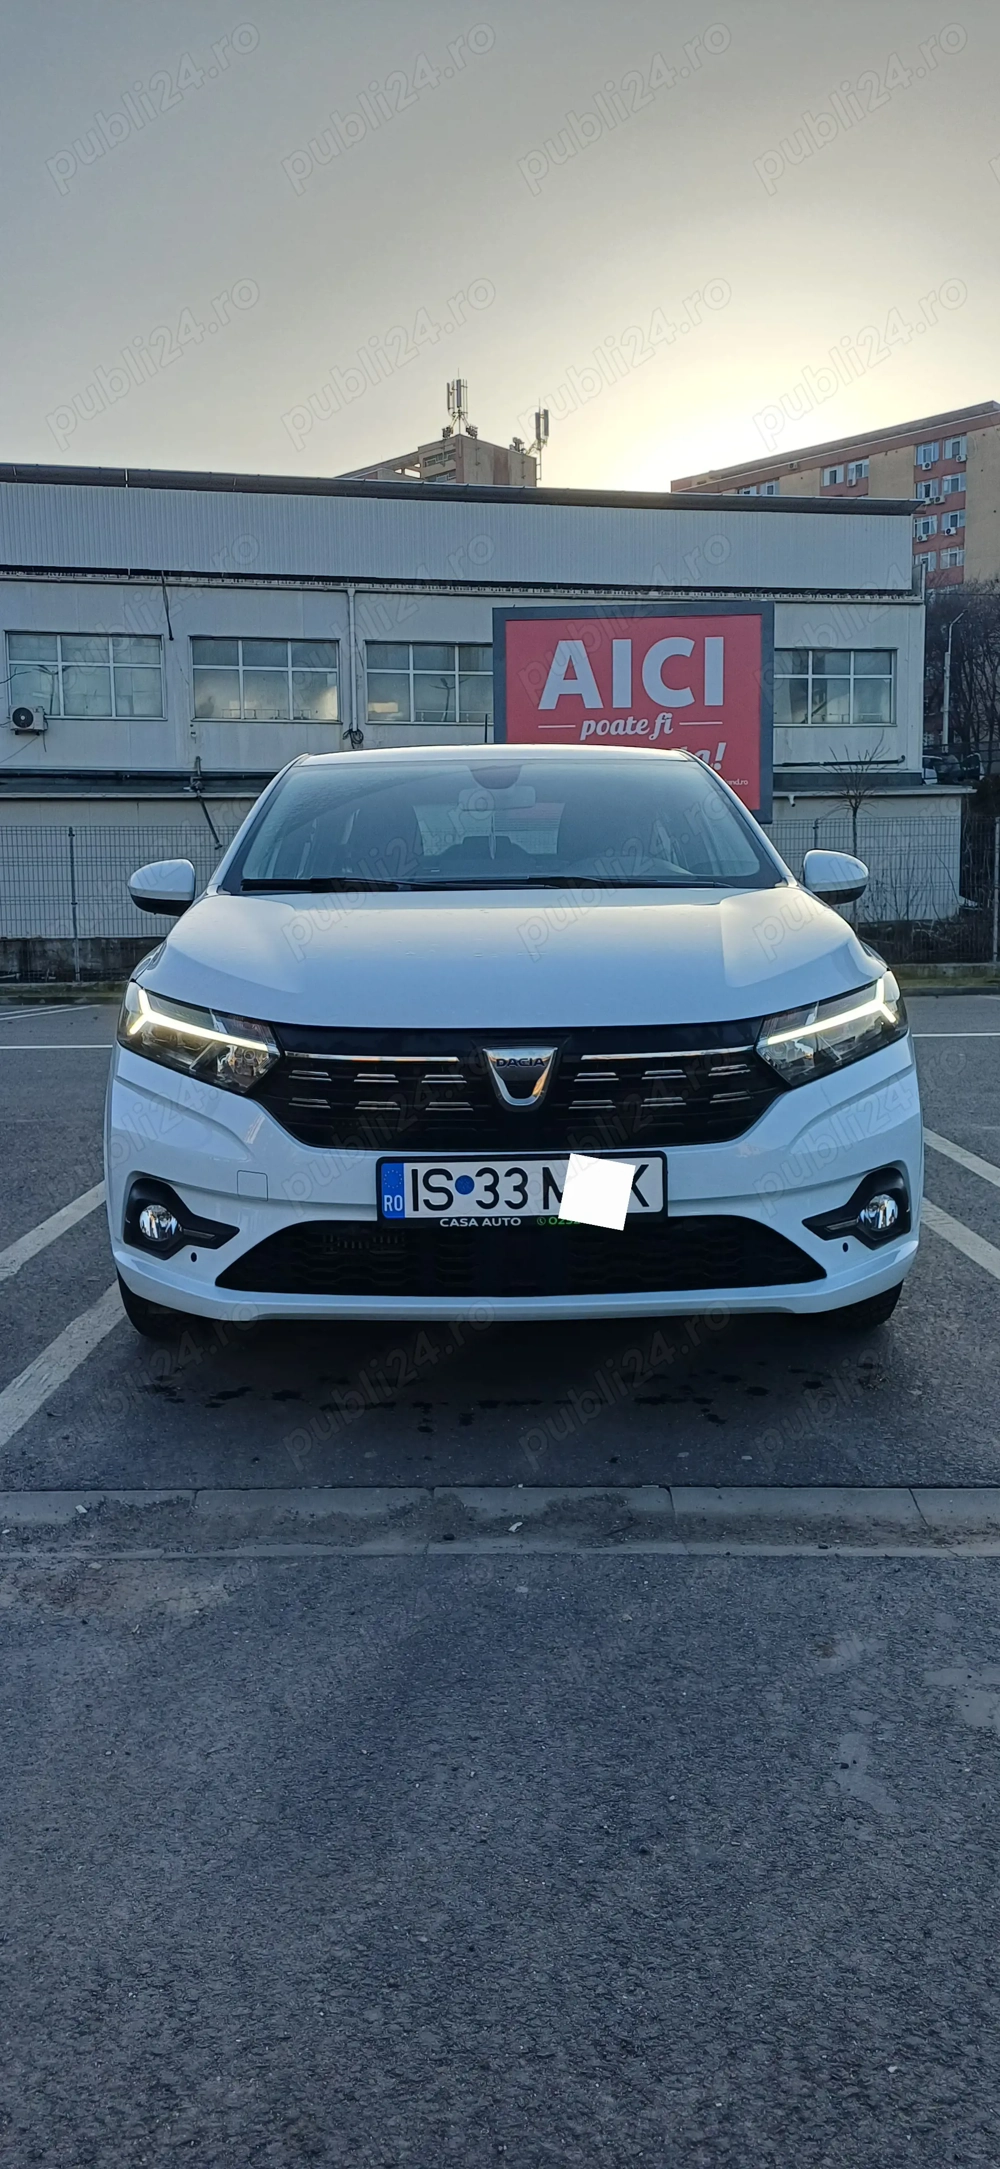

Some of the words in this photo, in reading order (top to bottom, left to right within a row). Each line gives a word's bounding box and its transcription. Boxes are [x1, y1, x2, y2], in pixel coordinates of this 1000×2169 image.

[538, 636, 724, 710] AICI
[580, 716, 650, 741] poate
[649, 712, 673, 741] fi
[496, 1058, 545, 1067] DACIA
[475, 1166, 529, 1210] 33
[383, 1194, 403, 1212] RO
[439, 1217, 479, 1227] CASA
[481, 1217, 522, 1227] AUTO
